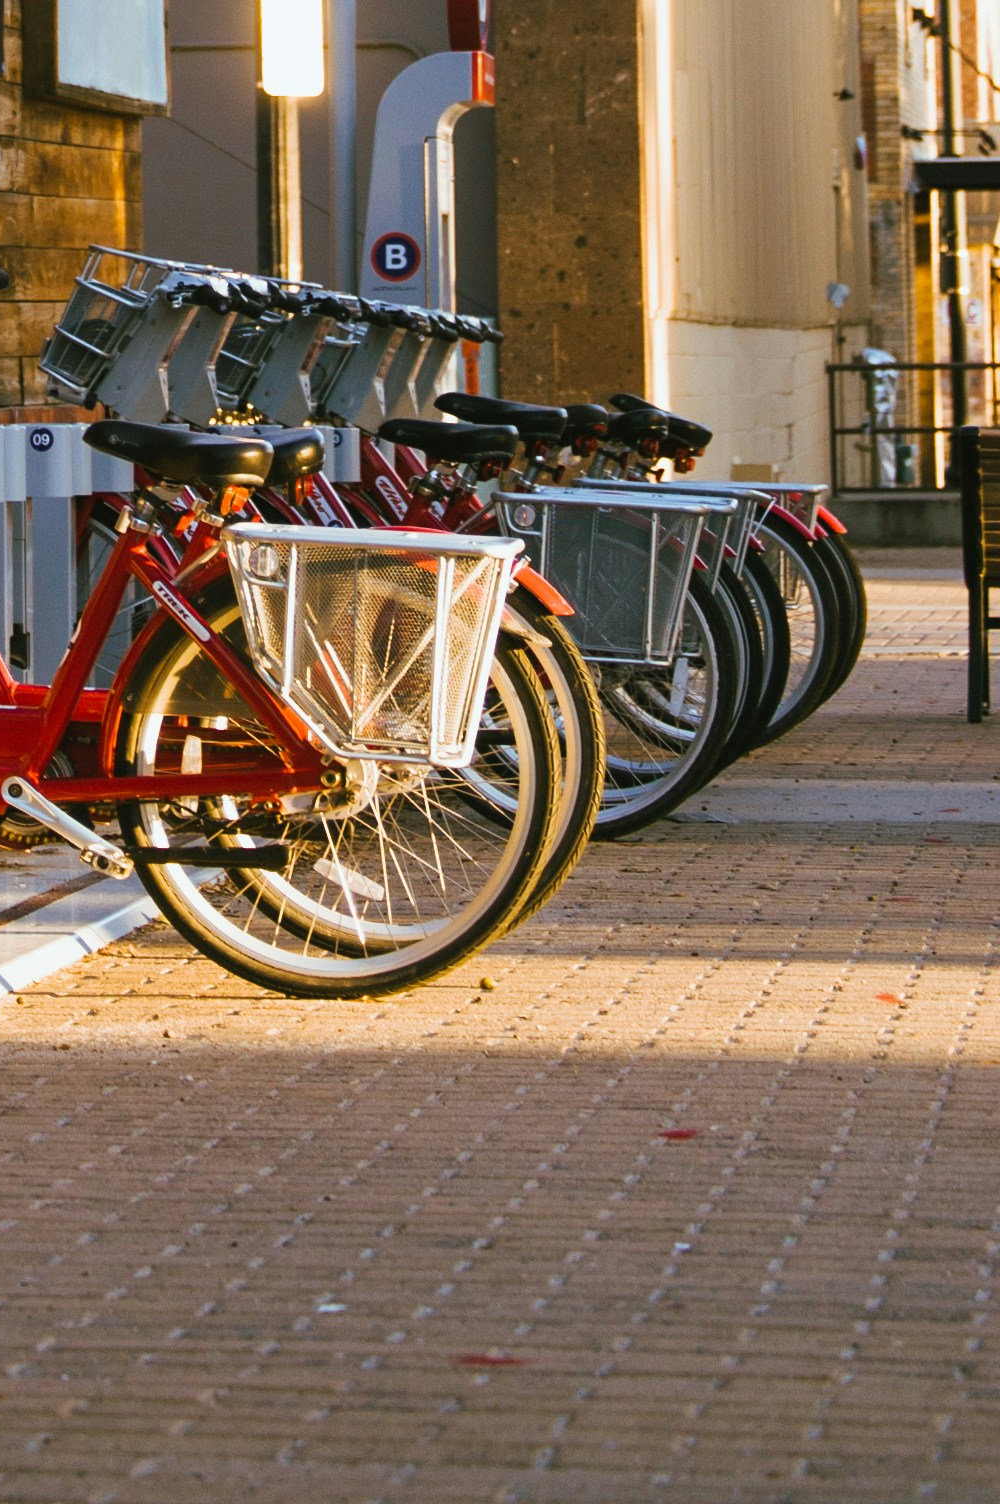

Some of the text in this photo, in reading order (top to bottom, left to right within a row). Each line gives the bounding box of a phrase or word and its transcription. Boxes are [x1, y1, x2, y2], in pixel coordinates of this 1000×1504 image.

[385, 244, 408, 270] B
[32, 433, 50, 446] 09
[157, 586, 190, 620] TREK
